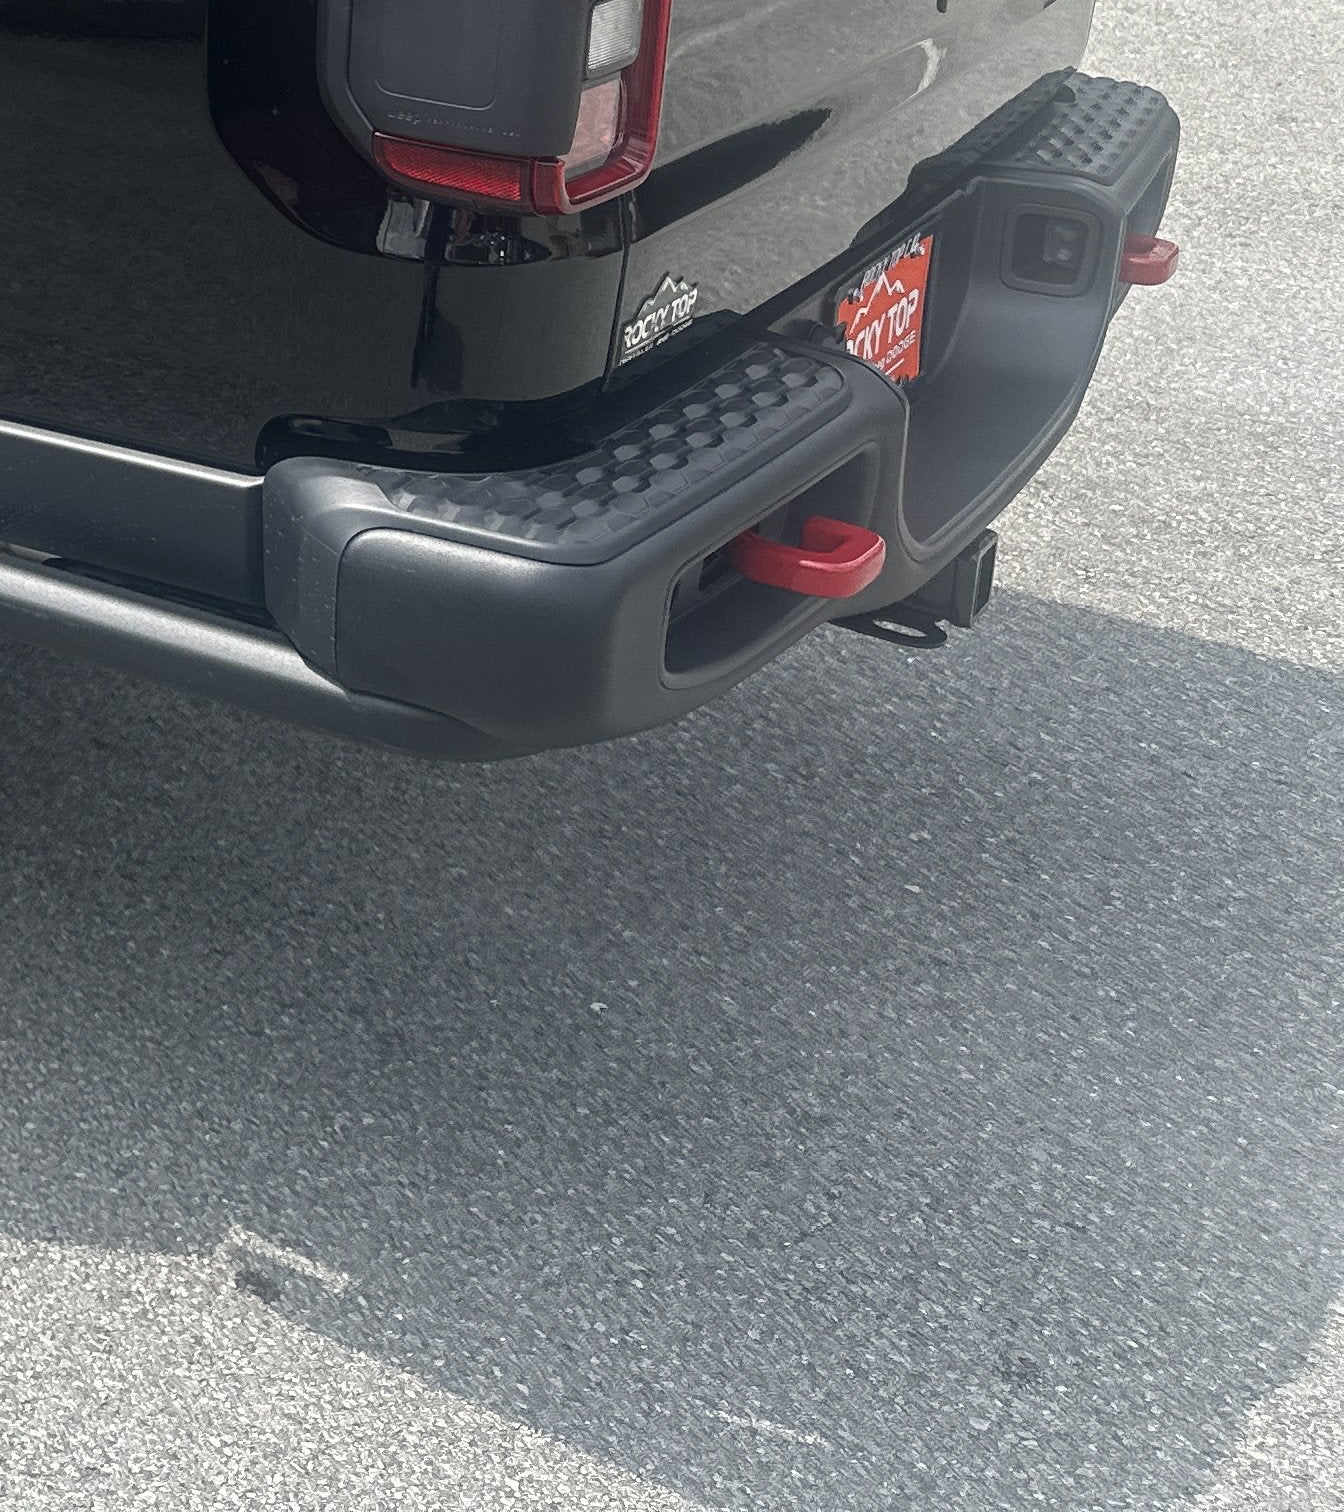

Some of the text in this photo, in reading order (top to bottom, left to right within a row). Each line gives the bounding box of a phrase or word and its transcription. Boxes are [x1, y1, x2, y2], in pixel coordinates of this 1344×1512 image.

[624, 304, 671, 348] ROCKY
[672, 288, 698, 323] TOP
[846, 288, 919, 360] CKY TOP
